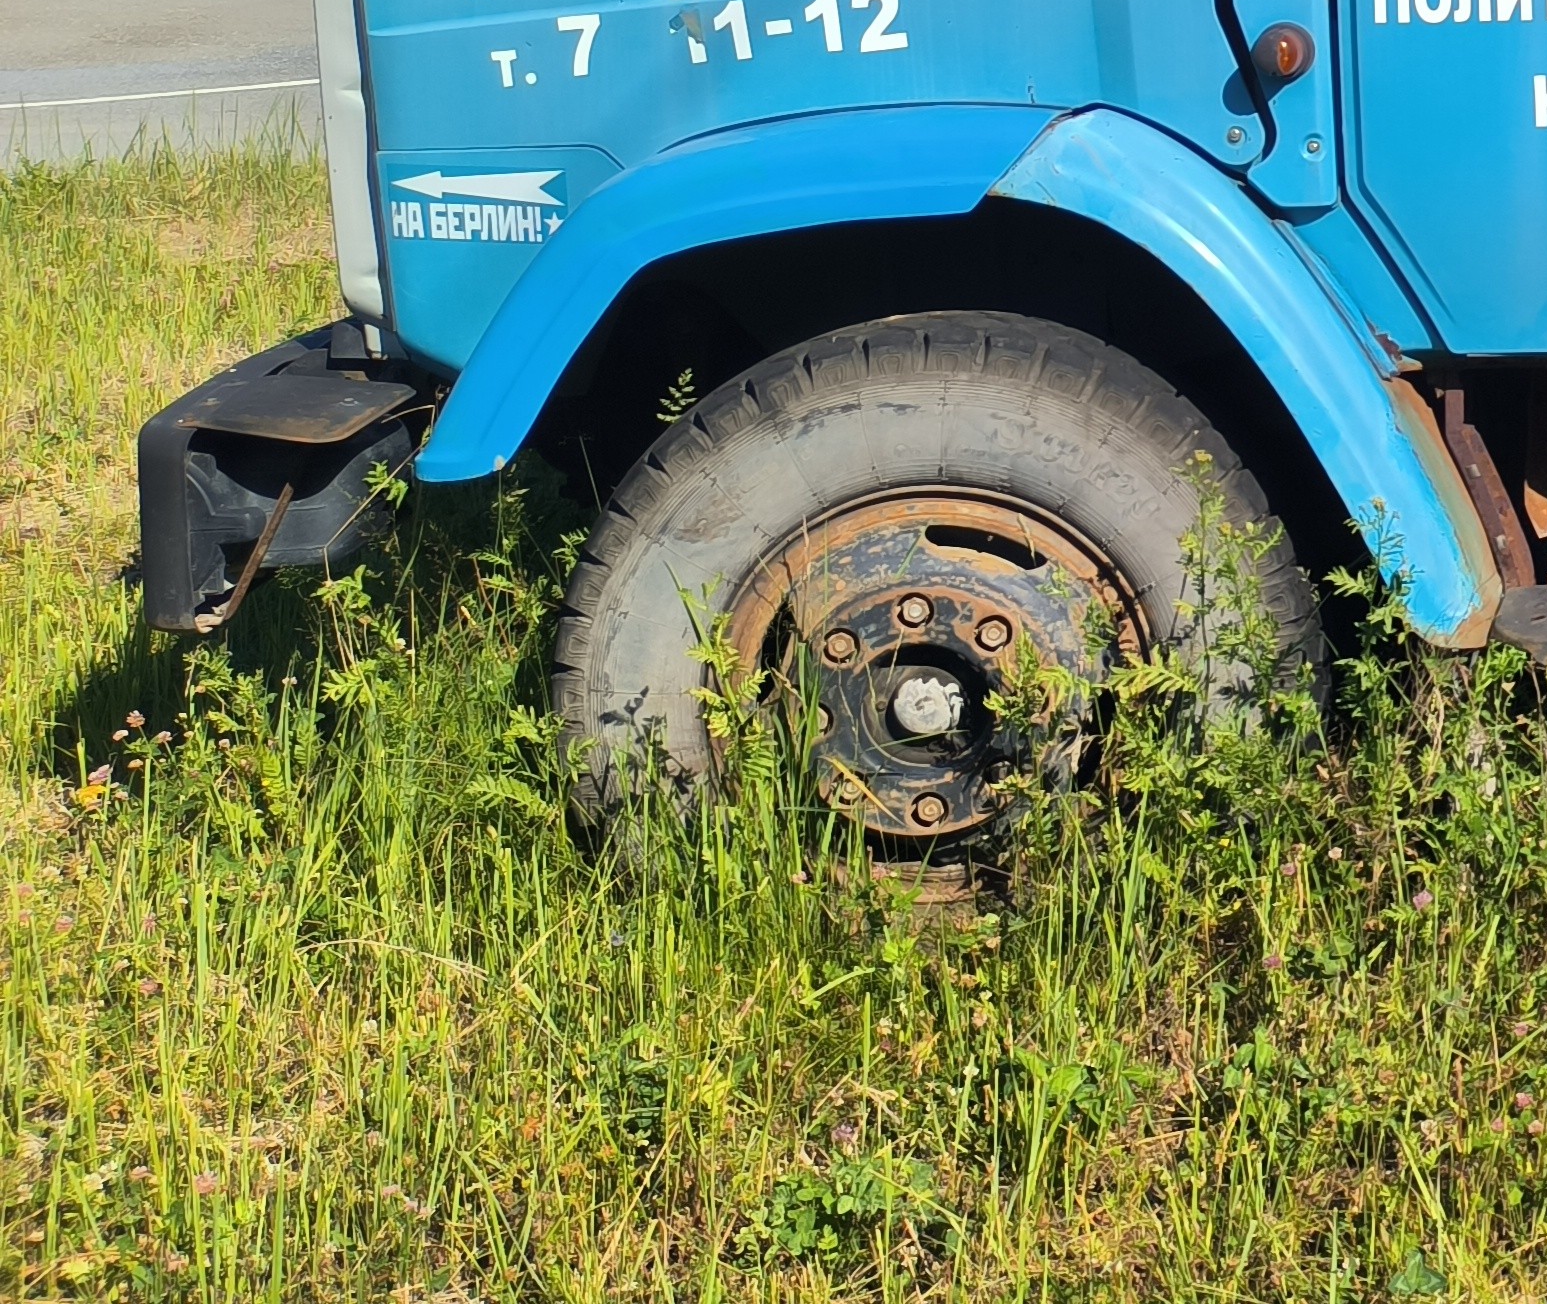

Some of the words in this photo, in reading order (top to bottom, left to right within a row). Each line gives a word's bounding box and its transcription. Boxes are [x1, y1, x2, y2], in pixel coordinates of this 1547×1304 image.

[490, 49, 537, 88] т.
[391, 200, 425, 239] НА
[429, 202, 543, 243] БЕРЛИН!
